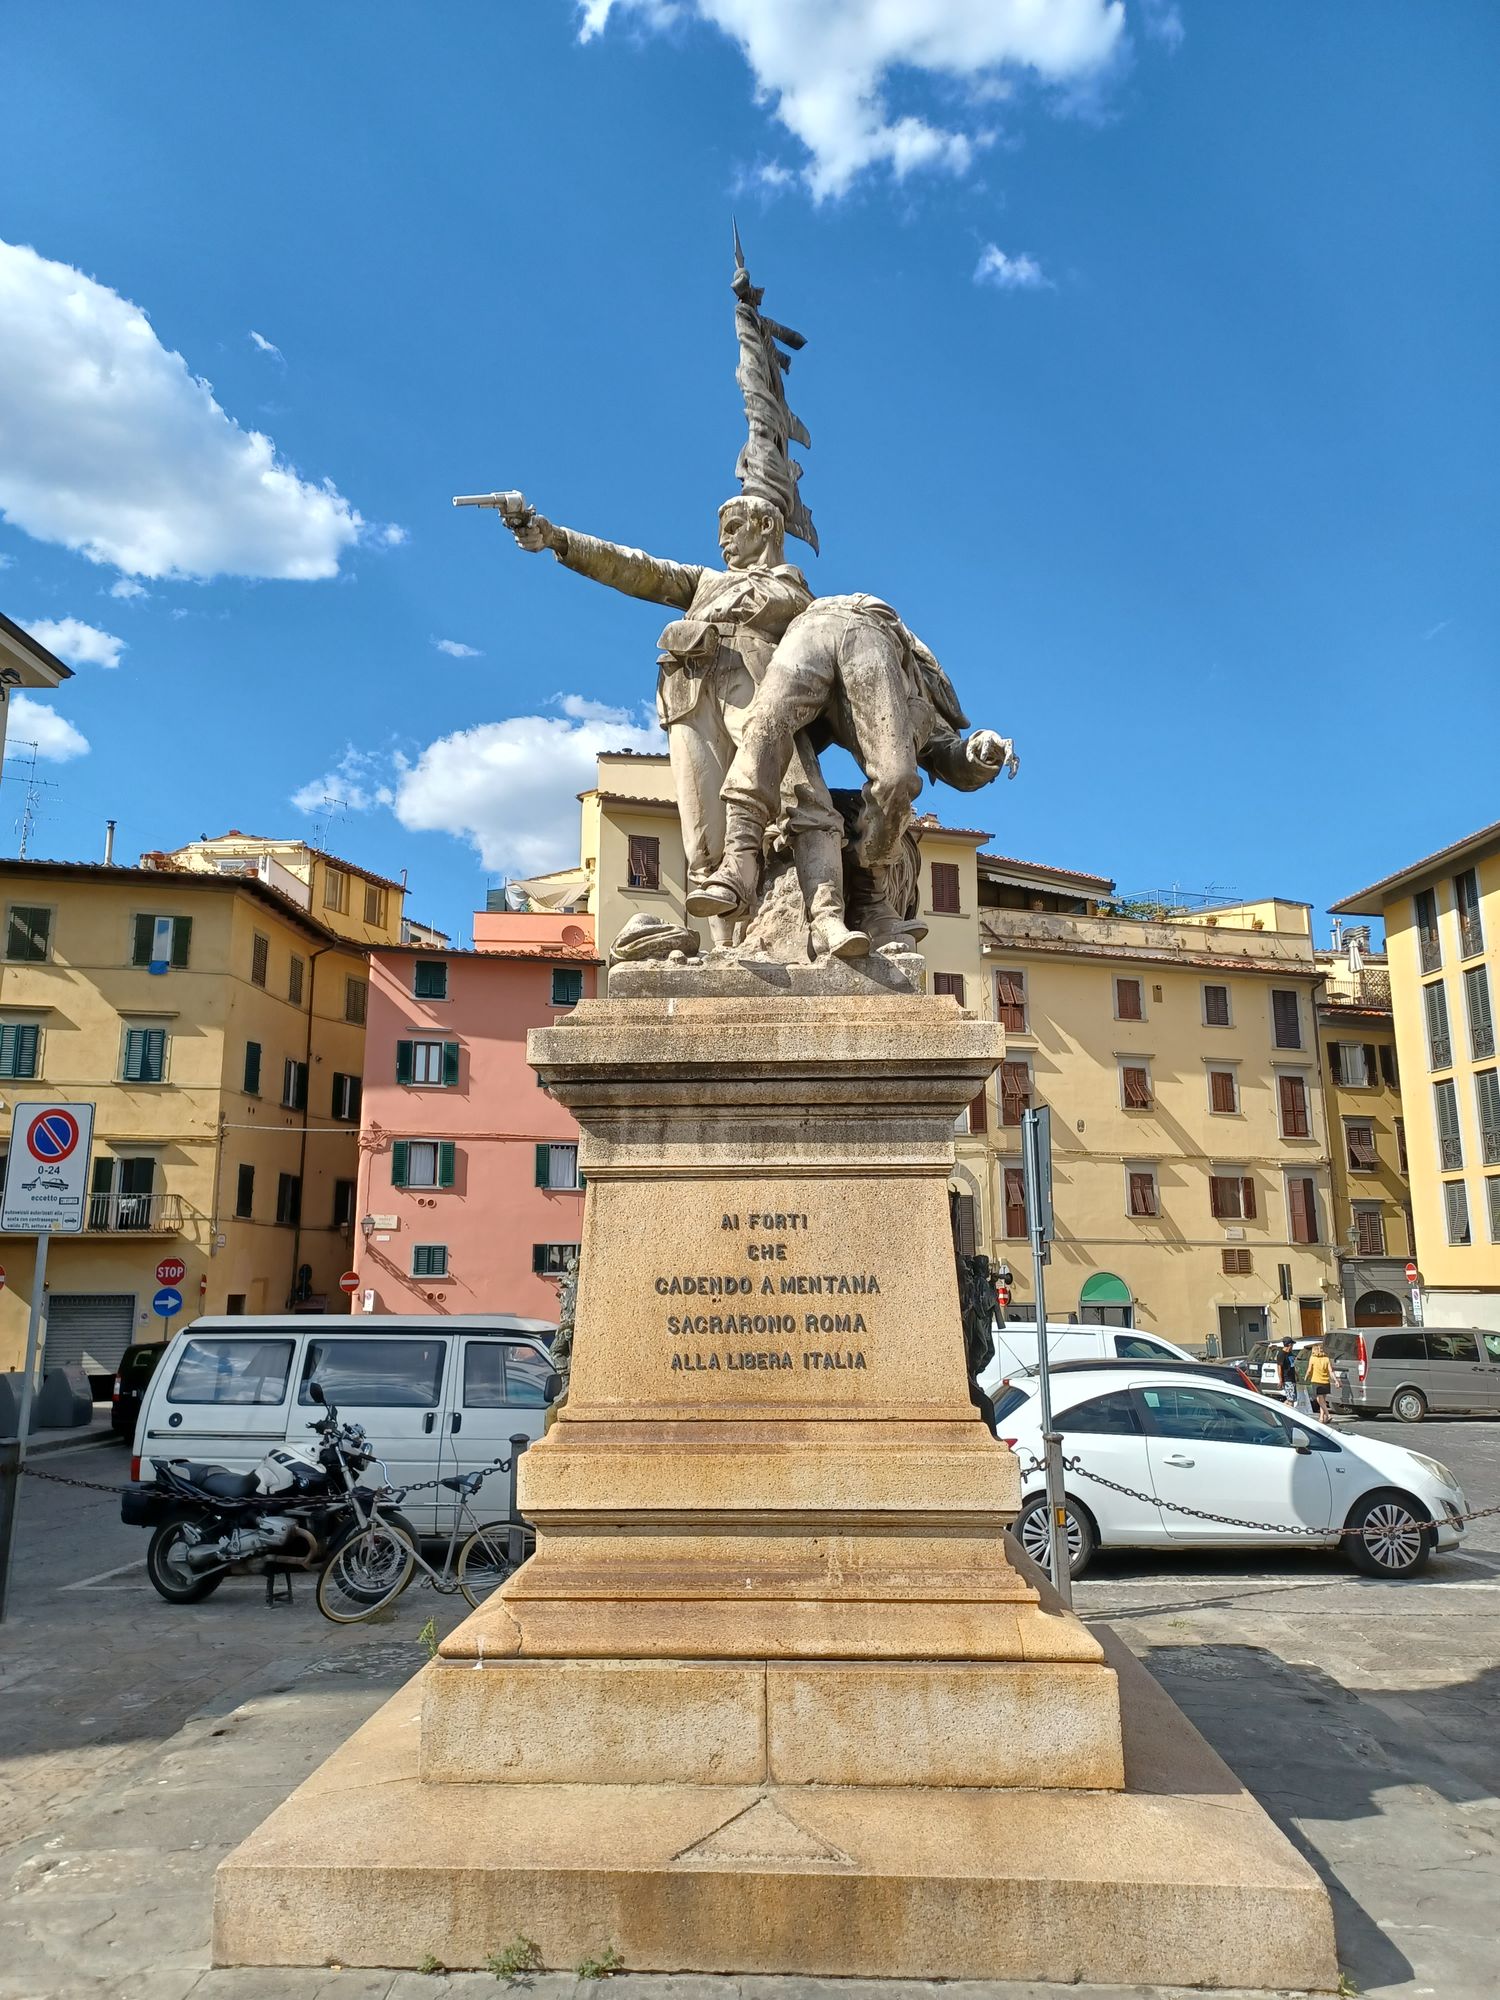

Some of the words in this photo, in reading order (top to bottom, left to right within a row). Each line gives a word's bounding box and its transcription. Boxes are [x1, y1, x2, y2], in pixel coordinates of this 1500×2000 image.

[38, 1165, 60, 1175] 0-24
[721, 1213, 740, 1230] AI
[749, 1213, 808, 1230] FORTI
[748, 1243, 787, 1261] CHE
[157, 1266, 184, 1278] STOP
[654, 1276, 753, 1295] CADENDO
[760, 1275, 775, 1295] A
[780, 1275, 881, 1295] MENTANA
[667, 1314, 797, 1335] SACRARONO
[805, 1313, 867, 1333] ROMA
[671, 1352, 721, 1371] ALLA
[727, 1351, 793, 1371] LIBERA
[803, 1351, 867, 1371] ITALIA
